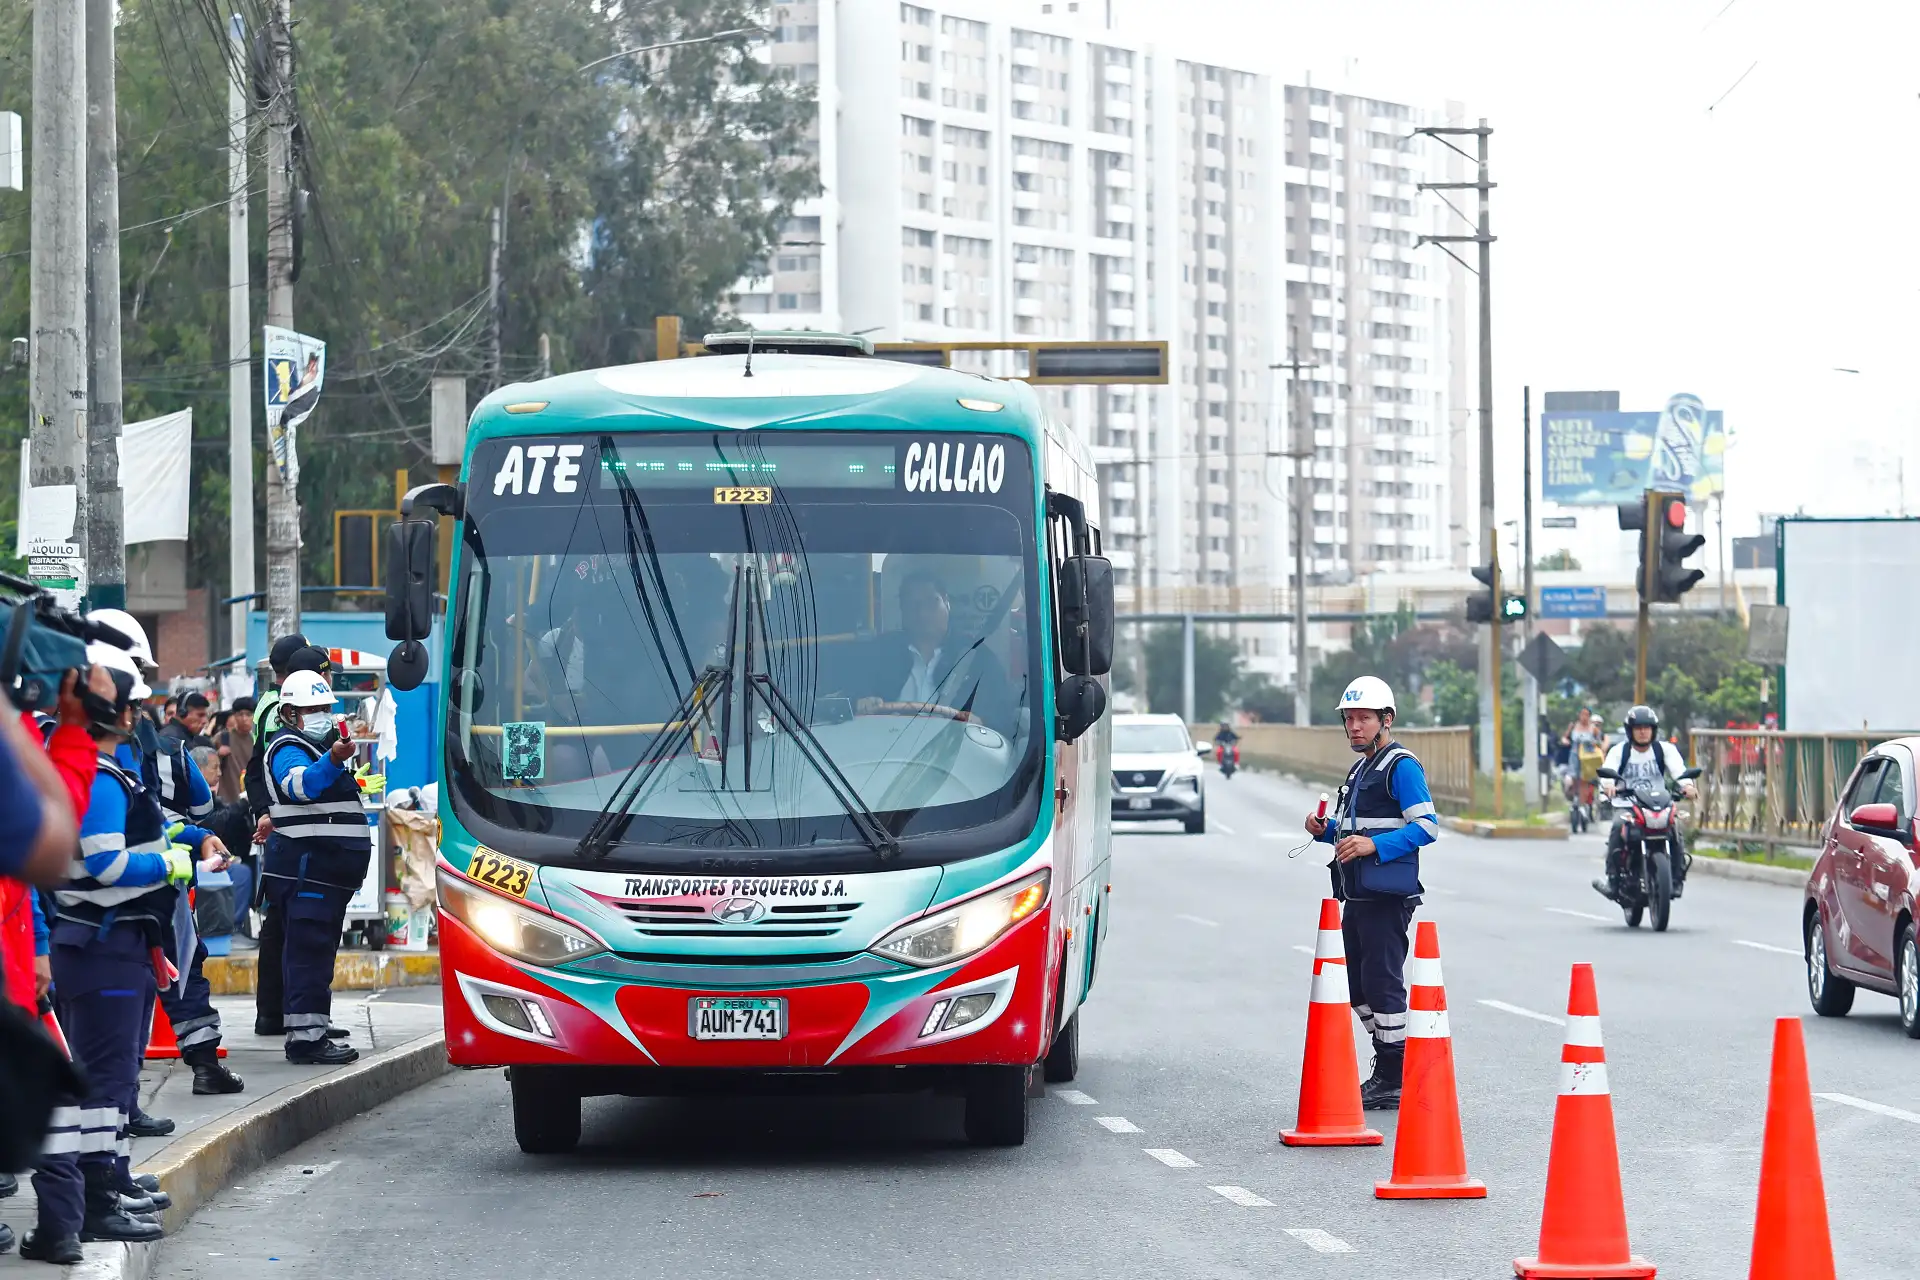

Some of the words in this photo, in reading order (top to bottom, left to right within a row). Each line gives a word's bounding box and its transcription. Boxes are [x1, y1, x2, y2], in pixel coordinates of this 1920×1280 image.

[493, 445, 584, 496] ATE
[904, 442, 1005, 494] CALLAO
[717, 490, 769, 502] 1223
[31, 546, 74, 555] ALQUILO
[1342, 690, 1363, 702] ATU
[495, 855, 515, 866] RUTA
[473, 854, 529, 895] 1223
[624, 879, 728, 898] TRANSPORTES
[732, 879, 819, 898] PESQUEROS
[821, 879, 848, 897] S.A.
[723, 1000, 754, 1009] PERU
[700, 1009, 777, 1033] AUM-741
